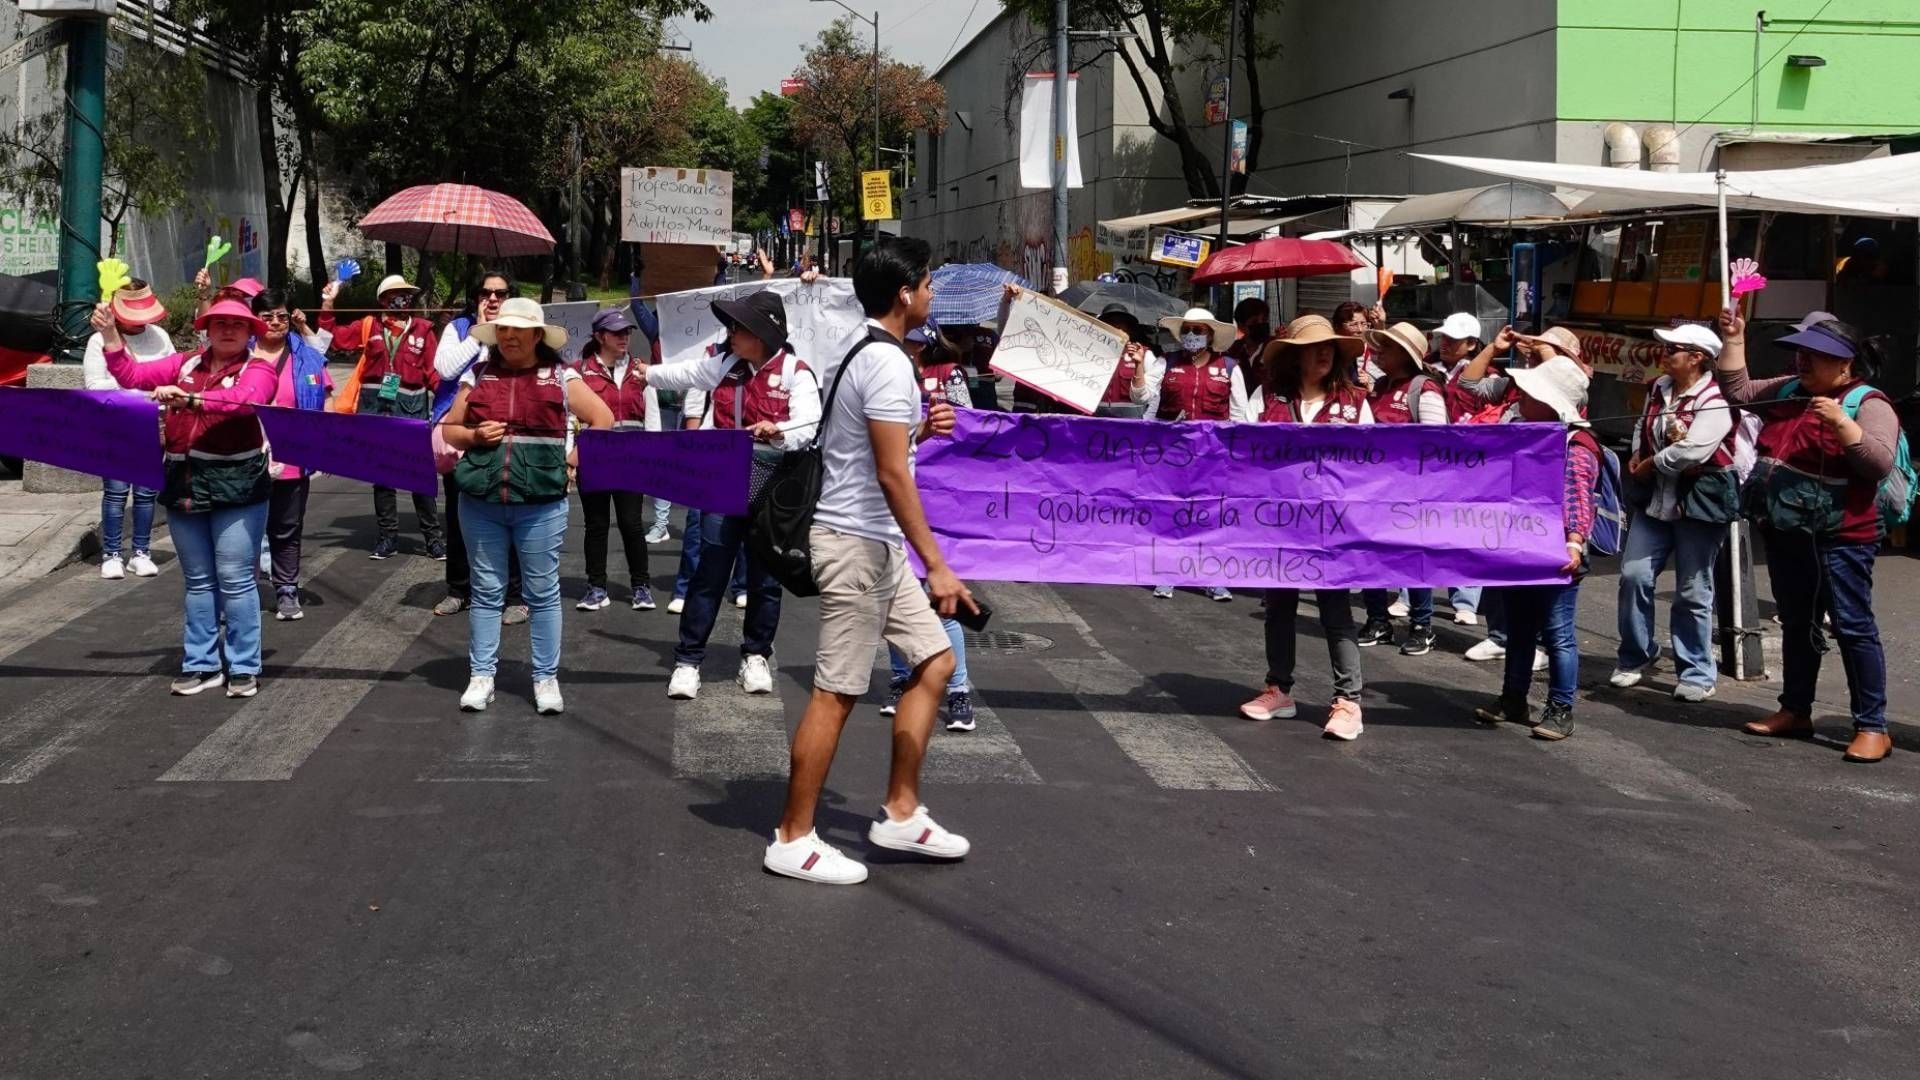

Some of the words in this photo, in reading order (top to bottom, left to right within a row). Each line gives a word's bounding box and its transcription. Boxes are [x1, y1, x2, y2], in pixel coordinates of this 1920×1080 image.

[632, 171, 726, 198] Profesionales
[645, 199, 709, 216] Servicios
[1419, 441, 1487, 476] para
[985, 481, 1010, 520] el
[1030, 489, 1153, 554] gobierno
[1254, 500, 1350, 536] CDMX
[1453, 507, 1549, 551] mejoras
[1151, 537, 1323, 583] Laborales
